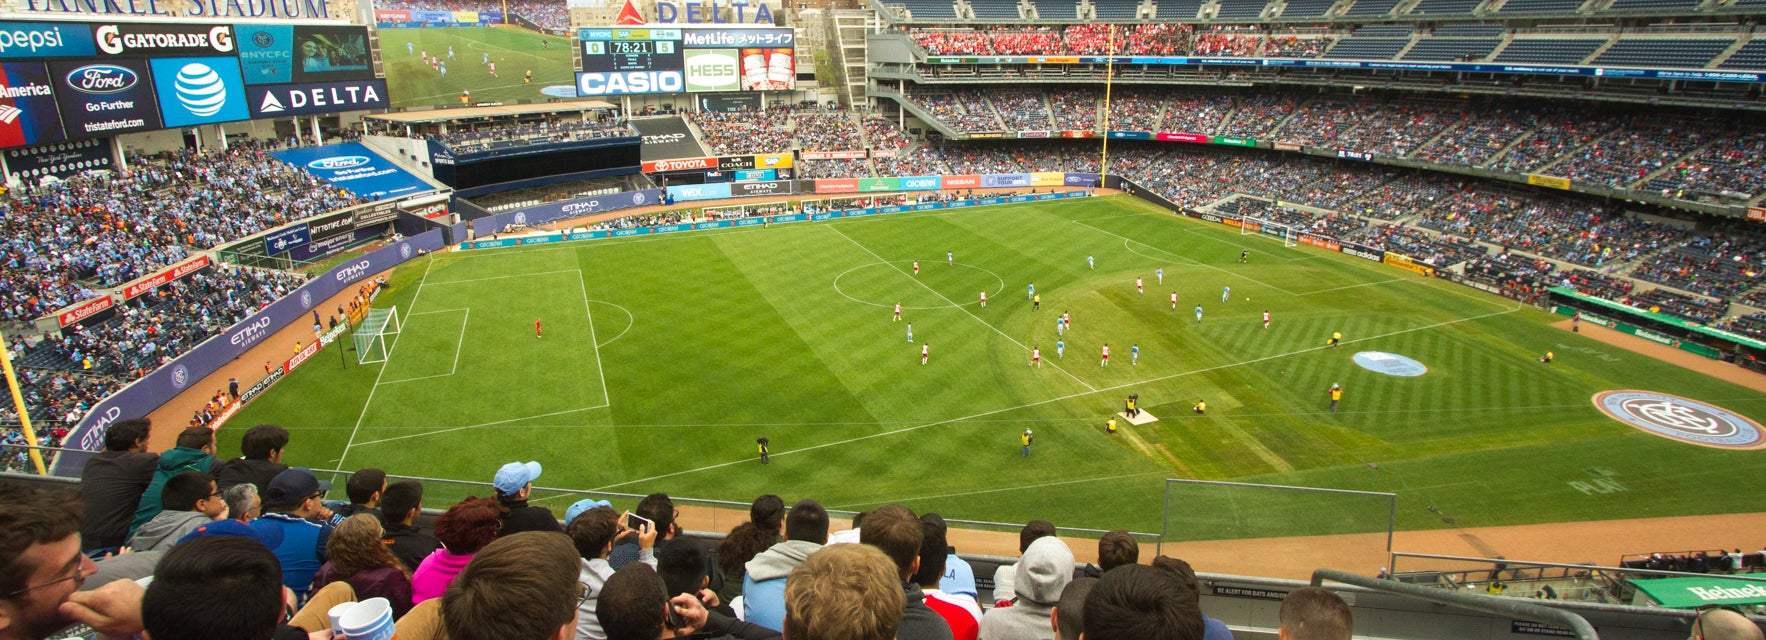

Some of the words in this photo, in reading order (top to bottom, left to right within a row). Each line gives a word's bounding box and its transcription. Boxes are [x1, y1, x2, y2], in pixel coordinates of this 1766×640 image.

[658, 1, 774, 24] DELTA
[0, 27, 64, 52] pepsi
[123, 33, 208, 48] GATORADE
[684, 32, 735, 45] MetLife
[739, 33, 793, 44] メットライフ
[591, 43, 599, 53] 0
[614, 42, 648, 53] 78:21
[661, 43, 669, 52] 5
[690, 64, 734, 77] HESS
[81, 68, 125, 89] Ford
[581, 71, 682, 95] CASIO
[0, 82, 52, 98] America
[289, 85, 380, 108] DELTA
[86, 103, 100, 112] Go
[101, 100, 134, 110] Further
[84, 119, 145, 132] tristateford.com
[669, 158, 707, 169] TOYOTA
[765, 157, 779, 166] SAP
[562, 200, 599, 212] ETIHAD
[336, 260, 370, 281] ETIHAD
[343, 271, 365, 284] AIRWAYS
[231, 316, 271, 345] ETIHAD
[1635, 328, 1672, 345] Heineken
[241, 330, 266, 348] AIRWAYS
[263, 367, 284, 385] ETIHAD
[241, 382, 263, 401] ETIHAD
[81, 406, 121, 451] ETIHAD
